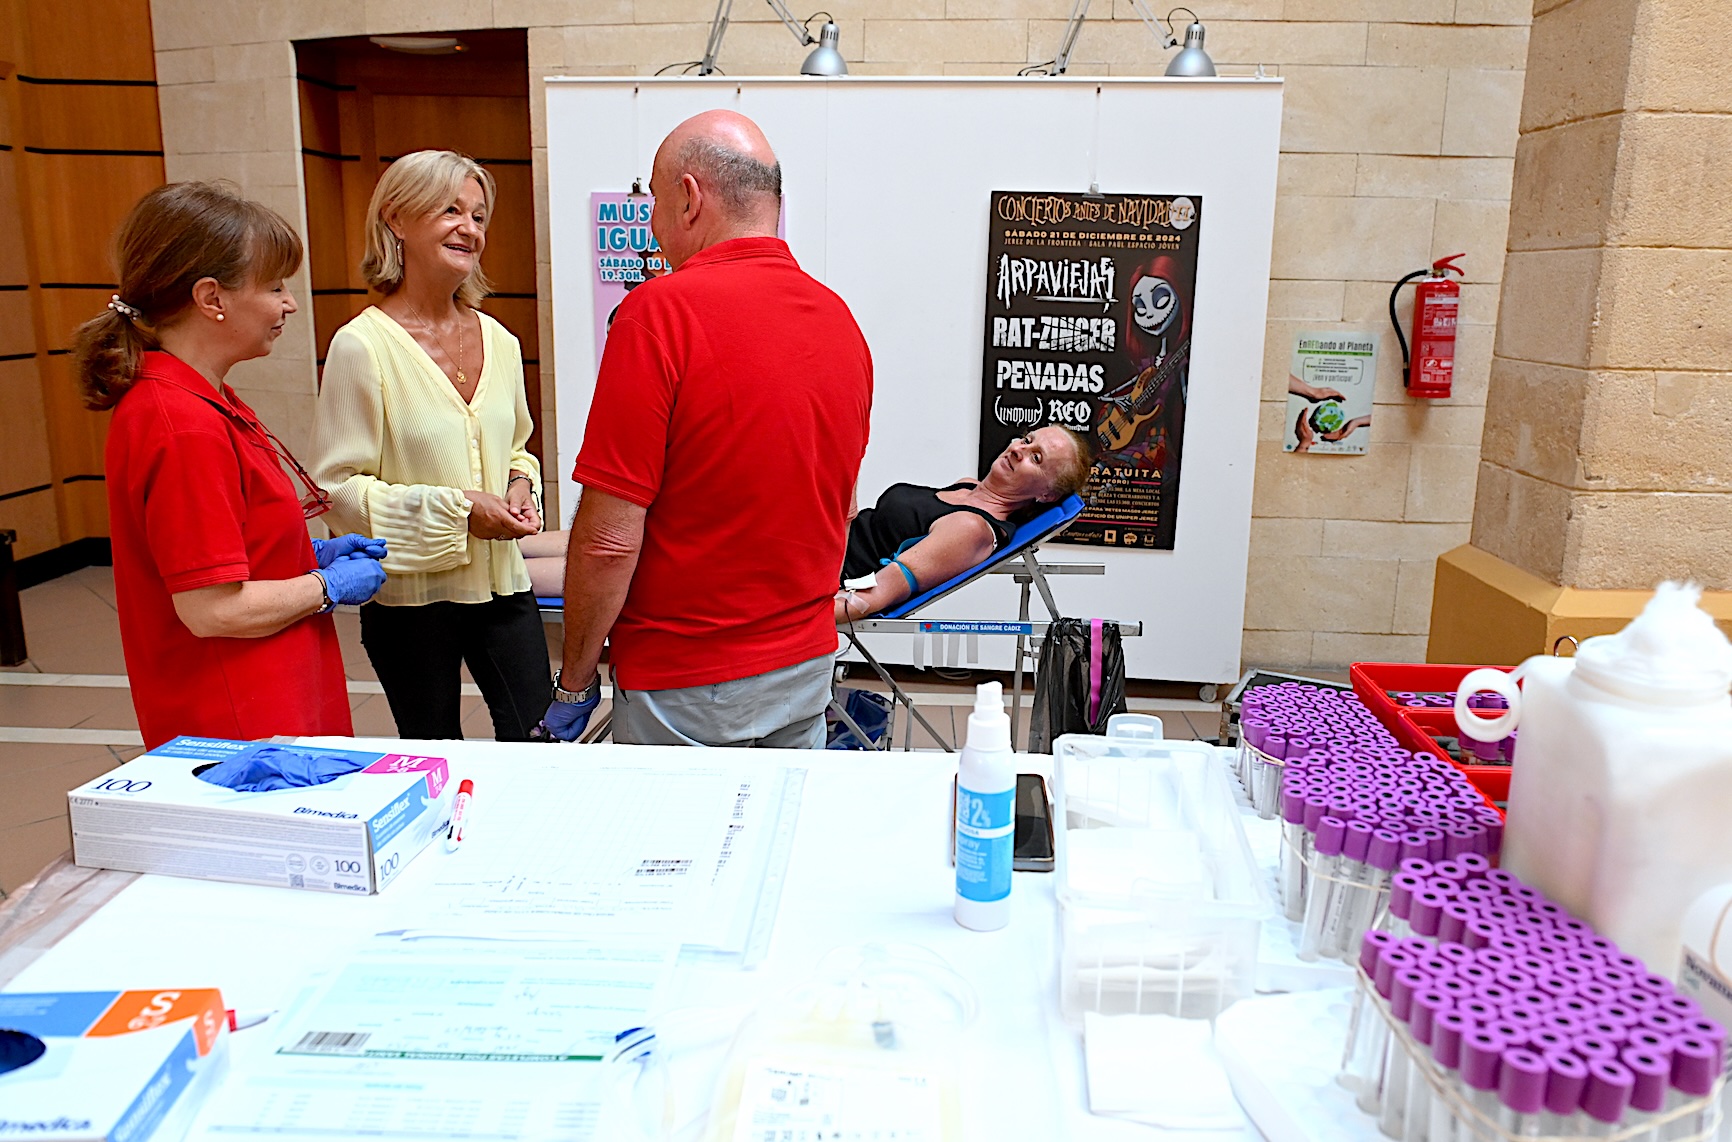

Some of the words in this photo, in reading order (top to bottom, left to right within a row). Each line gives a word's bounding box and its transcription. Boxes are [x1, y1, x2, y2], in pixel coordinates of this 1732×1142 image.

[998, 195, 1072, 227] CONCIERTOS
[1073, 201, 1101, 223] ANTES
[1102, 203, 1116, 223] DE
[1117, 196, 1175, 231] NAVIDAD
[1004, 229, 1047, 239] SÁBADO
[1049, 231, 1060, 239] 21
[1079, 232, 1137, 241] DICIEMBRE
[1139, 233, 1153, 241] DE
[1155, 234, 1181, 242] 2024
[1004, 238, 1023, 246] JEREZ
[1037, 239, 1045, 247] LA
[1127, 241, 1156, 249] ESPACIO
[600, 256, 643, 268] SÁBADO
[649, 259, 661, 268] 16
[996, 253, 1116, 312] ARPAVIEJAS
[993, 316, 1116, 352] RAT-ZINGER
[1347, 341, 1374, 352] Planeta
[997, 361, 1105, 393] PENADAS
[1048, 399, 1091, 423] REO
[940, 623, 970, 631] DONACIÓN
[176, 739, 248, 751] Sensiflex
[391, 756, 428, 769] M
[431, 767, 443, 788] M
[91, 778, 152, 793] 100
[293, 806, 357, 819] Bimedica
[372, 796, 411, 834] Sensiflex
[335, 859, 361, 874] 100
[380, 852, 400, 881] 100
[333, 882, 367, 892] Bimedica
[140, 991, 182, 1017] S
